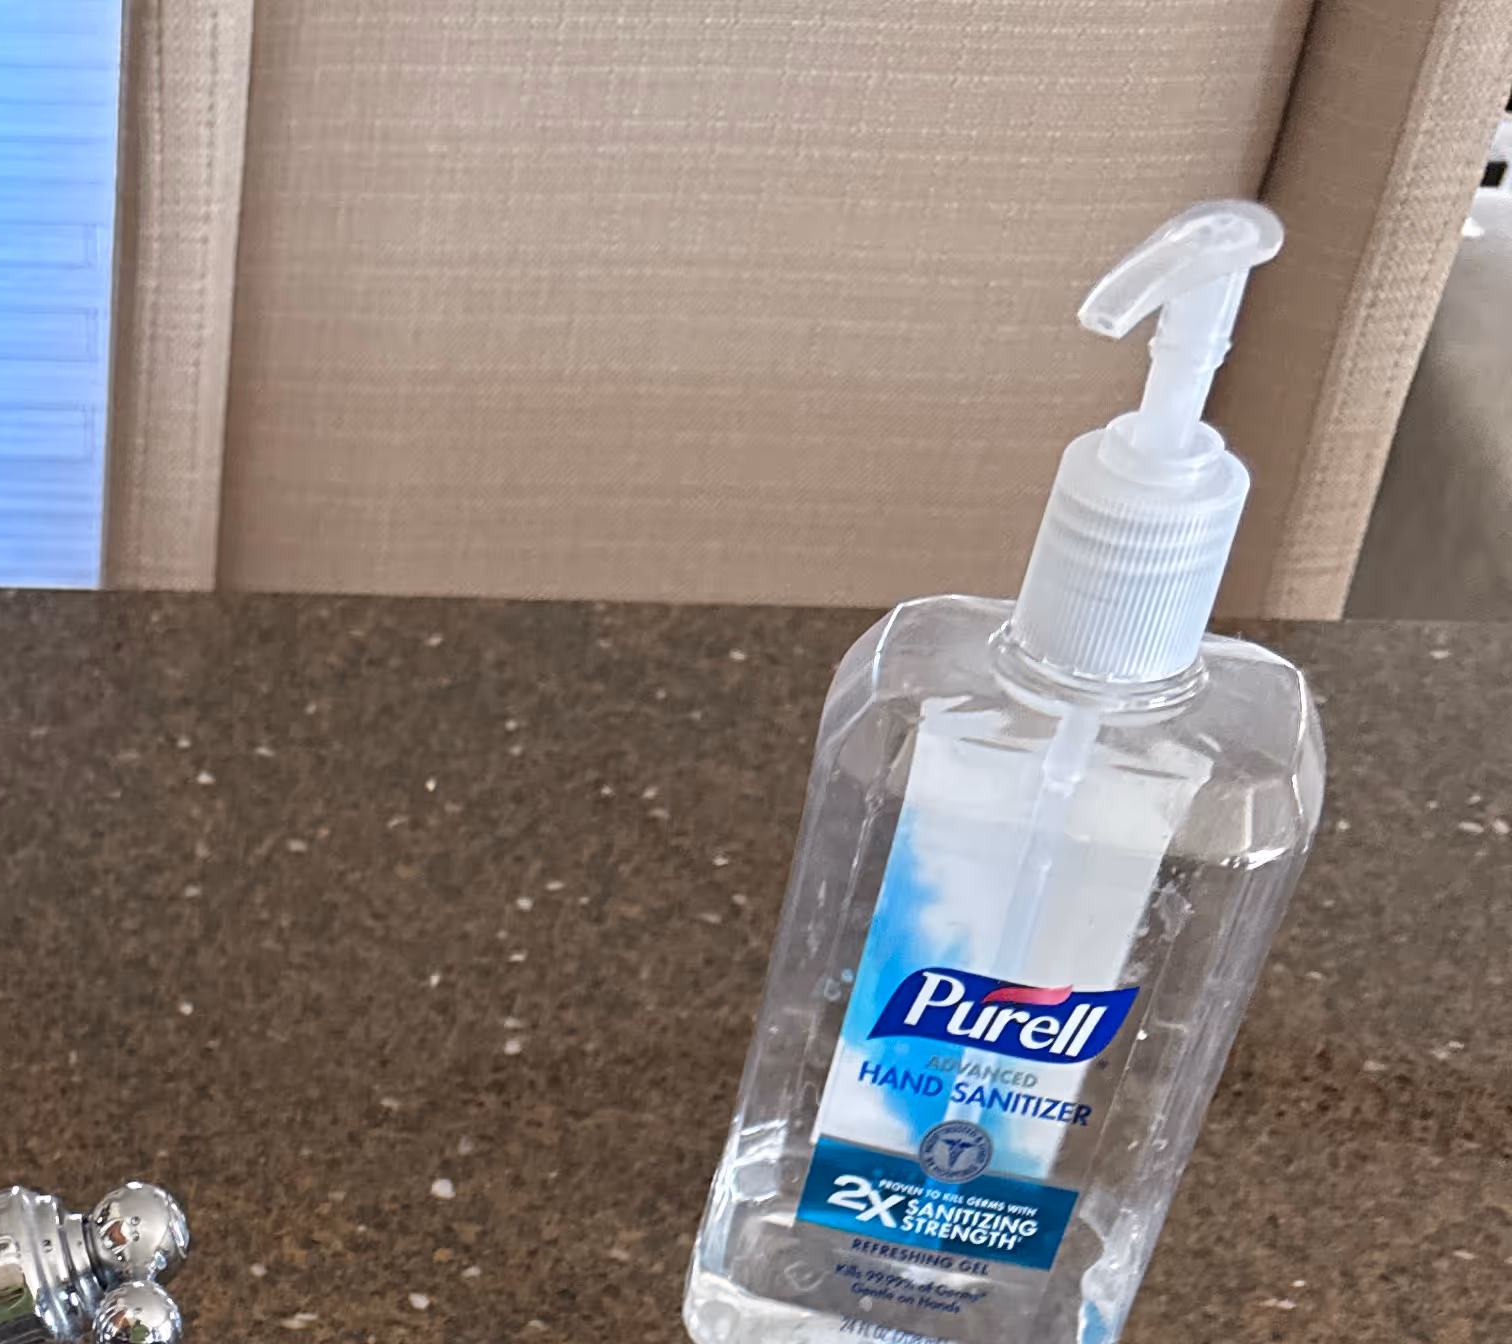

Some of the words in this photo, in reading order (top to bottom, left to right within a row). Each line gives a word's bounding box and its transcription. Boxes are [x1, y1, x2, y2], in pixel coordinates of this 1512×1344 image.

[903, 971, 1108, 1057] Purell
[925, 1055, 1038, 1088] ADVANCED
[858, 1061, 943, 1097] HAND
[950, 1081, 1093, 1127] SANITIZER
[826, 1174, 906, 1229] 2X
[878, 1178, 924, 1197] PROVEN
[924, 1188, 941, 1201] TO
[943, 1191, 964, 1205] KILL
[967, 1195, 1006, 1213] GERMS
[1007, 1203, 1038, 1218] WITH
[905, 1198, 1039, 1237] SANITIZING
[851, 1238, 954, 1269] REFRESHING
[958, 1259, 989, 1276] GEL
[896, 1294, 915, 1305] on
[917, 1296, 961, 1315] Hands
